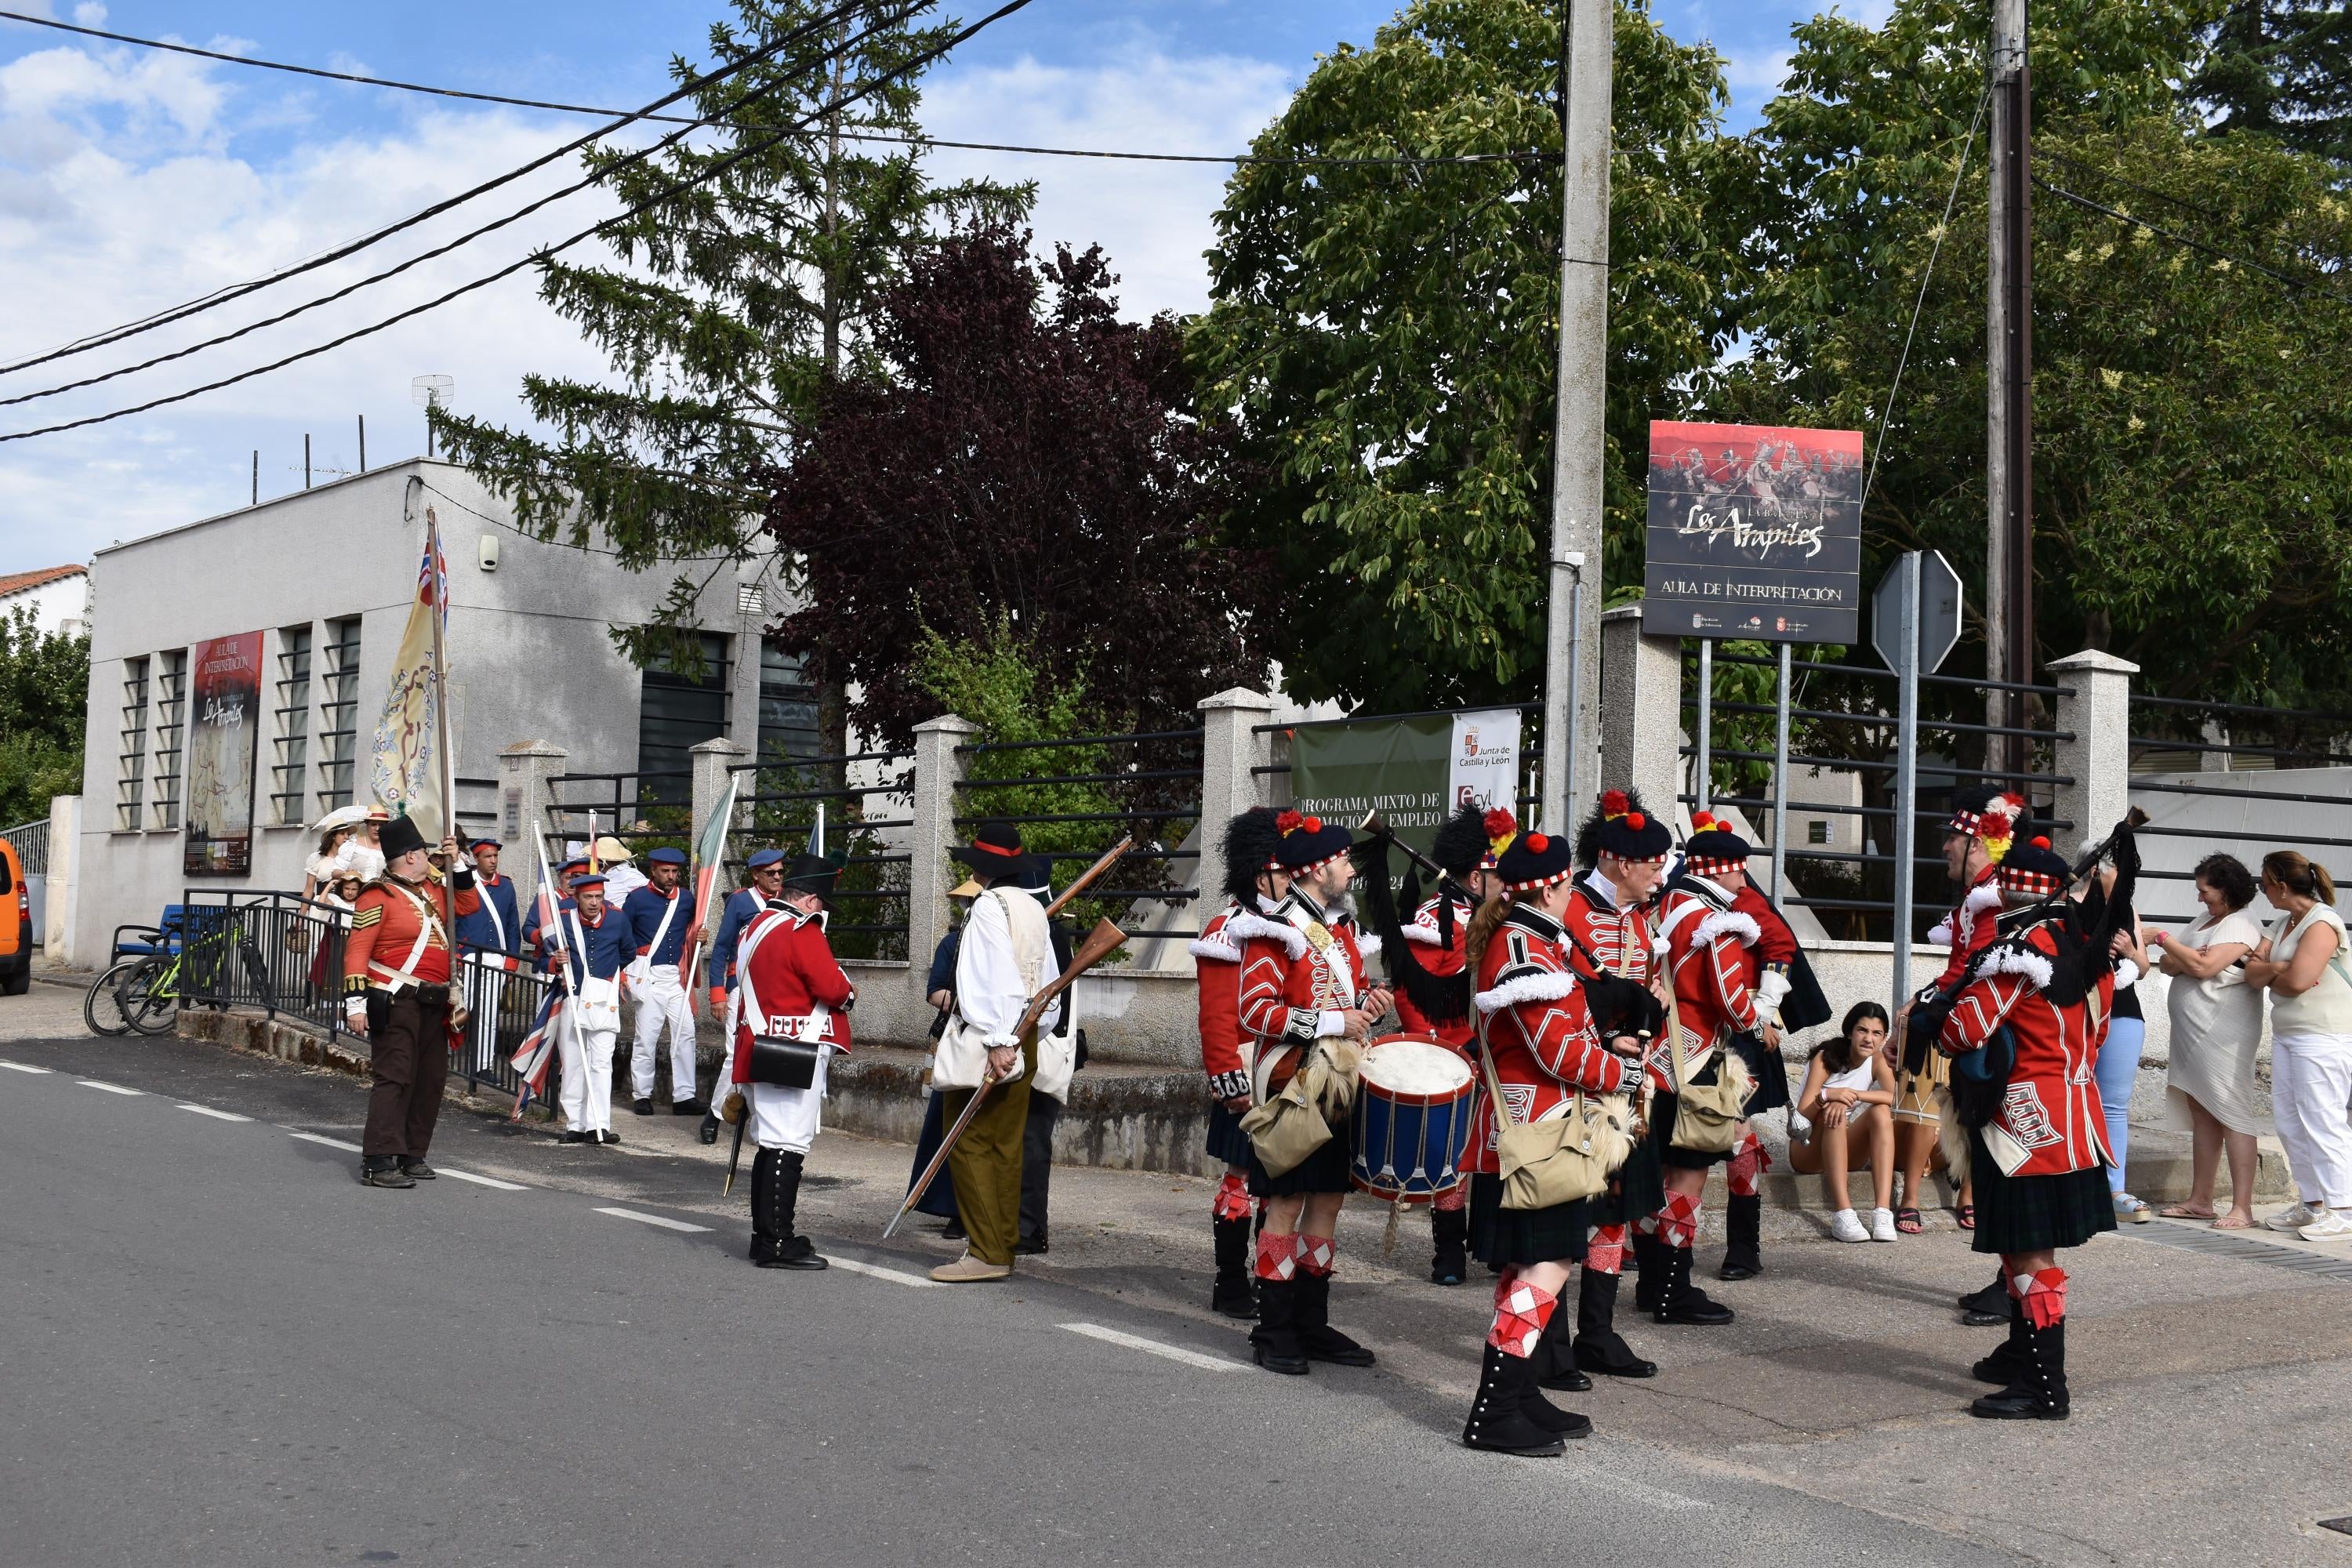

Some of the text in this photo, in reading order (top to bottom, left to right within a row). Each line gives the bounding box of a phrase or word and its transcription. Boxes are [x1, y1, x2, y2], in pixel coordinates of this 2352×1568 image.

[1679, 504, 1824, 560] Los Arapiles
[1661, 581, 1842, 601] AULA DE INTERPRETACIÓN
[216, 641, 238, 656] AULA DE
[205, 654, 249, 674] INTERPRETACIÓN
[1460, 757, 1483, 767] Castilla
[1491, 756, 1510, 765] León
[1301, 793, 1440, 813] PROGRAMA MIXTO DE
[1461, 786, 1492, 811] ecyl
[1389, 811, 1441, 828] EMPLEO
